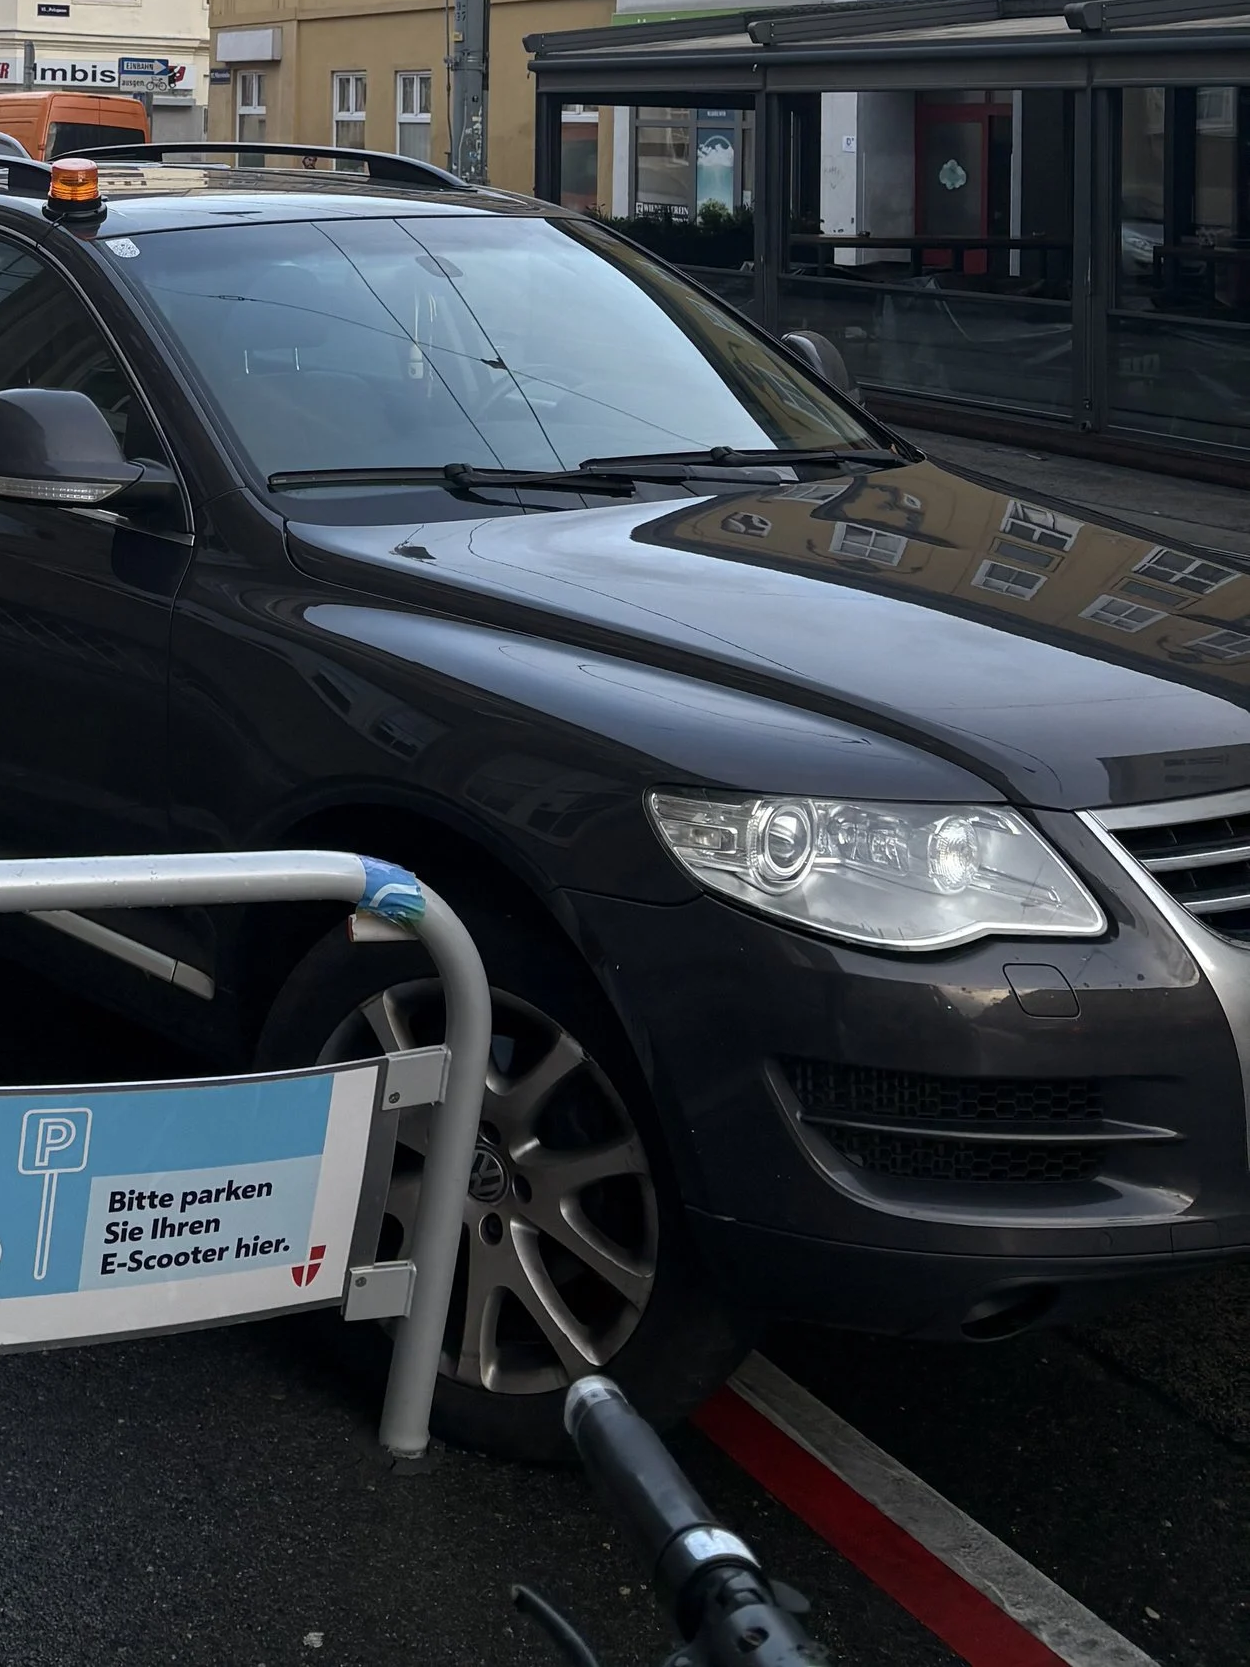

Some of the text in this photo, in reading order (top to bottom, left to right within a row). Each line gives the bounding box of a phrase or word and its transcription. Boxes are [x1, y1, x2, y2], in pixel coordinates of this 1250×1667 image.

[33, 63, 116, 83] Imbis
[125, 62, 154, 71] EINBAHN
[121, 79, 145, 87] ausgen.
[34, 1117, 77, 1167] P
[108, 1180, 273, 1213] Bitte parken
[103, 1216, 221, 1245] Sie Ihren
[100, 1235, 290, 1276] E-Scooter hier.
